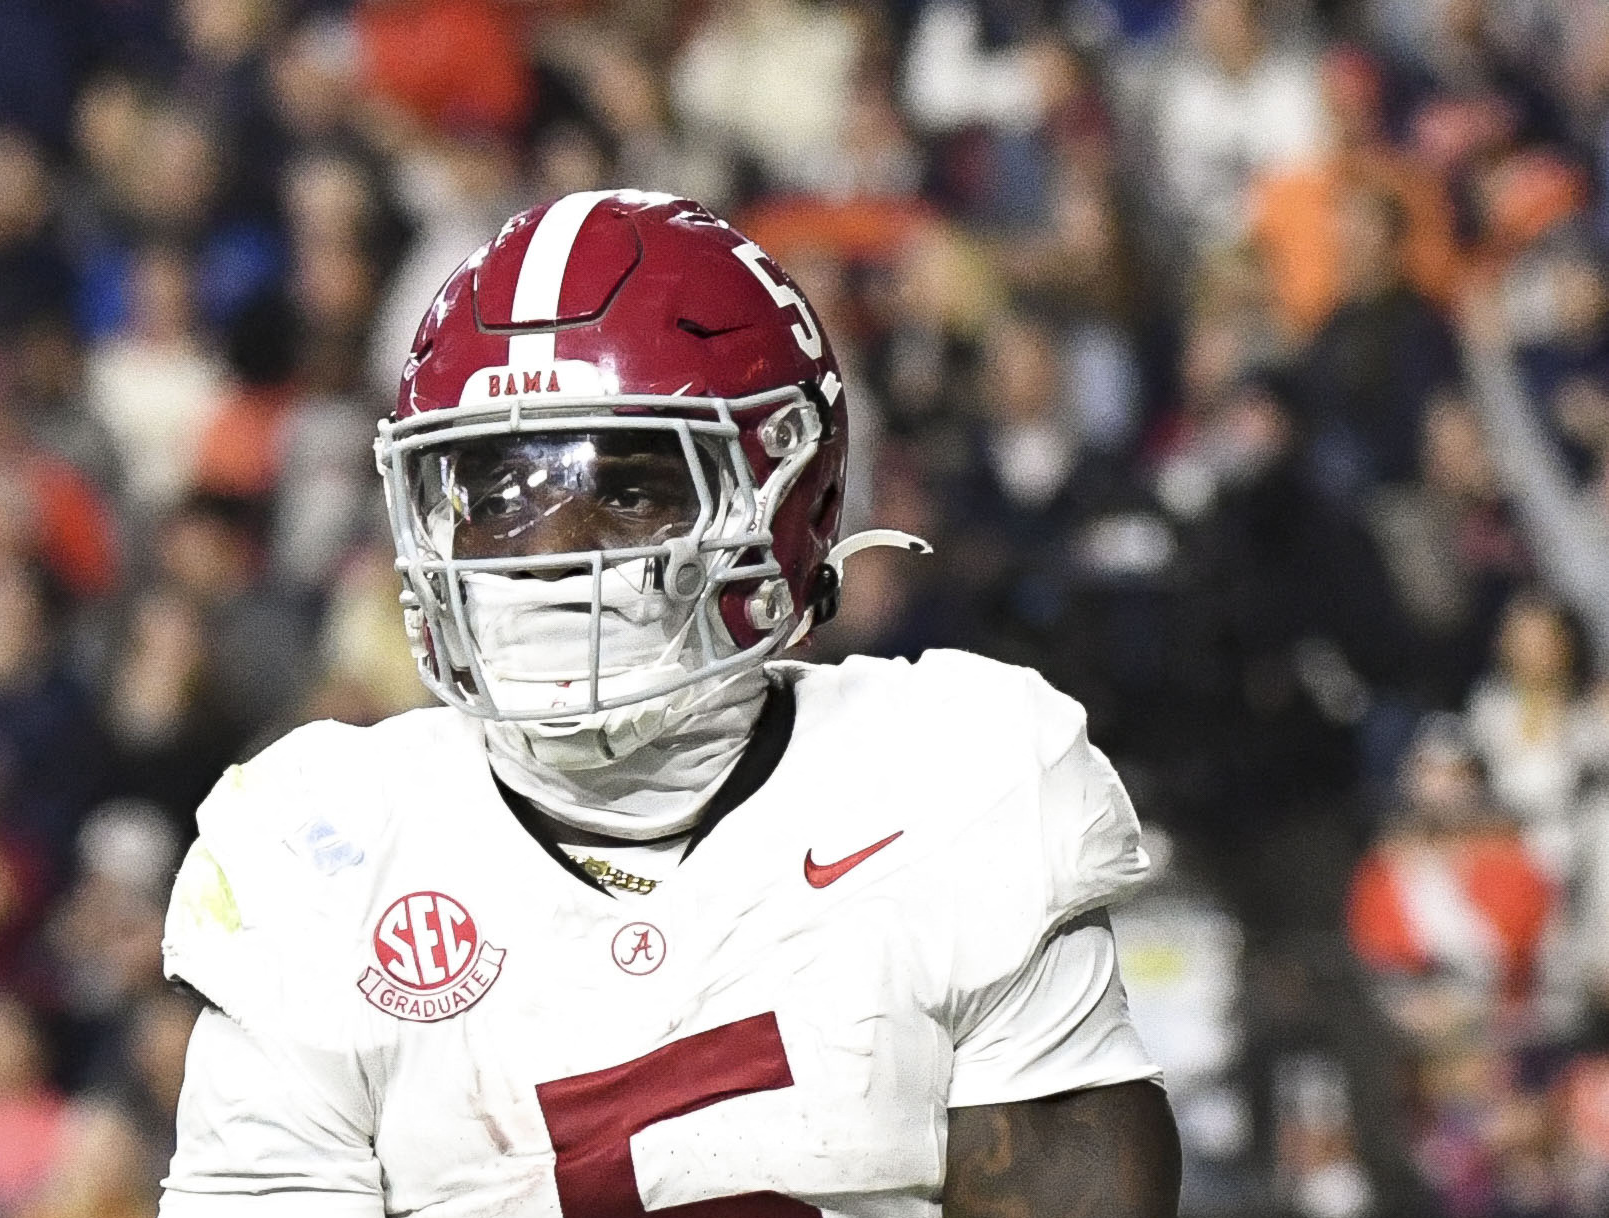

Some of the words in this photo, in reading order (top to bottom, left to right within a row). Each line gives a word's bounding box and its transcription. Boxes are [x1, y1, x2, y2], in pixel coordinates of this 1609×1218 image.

[488, 370, 561, 398] BAMA
[378, 895, 472, 987] SEC
[380, 969, 490, 1018] GRADUATE
